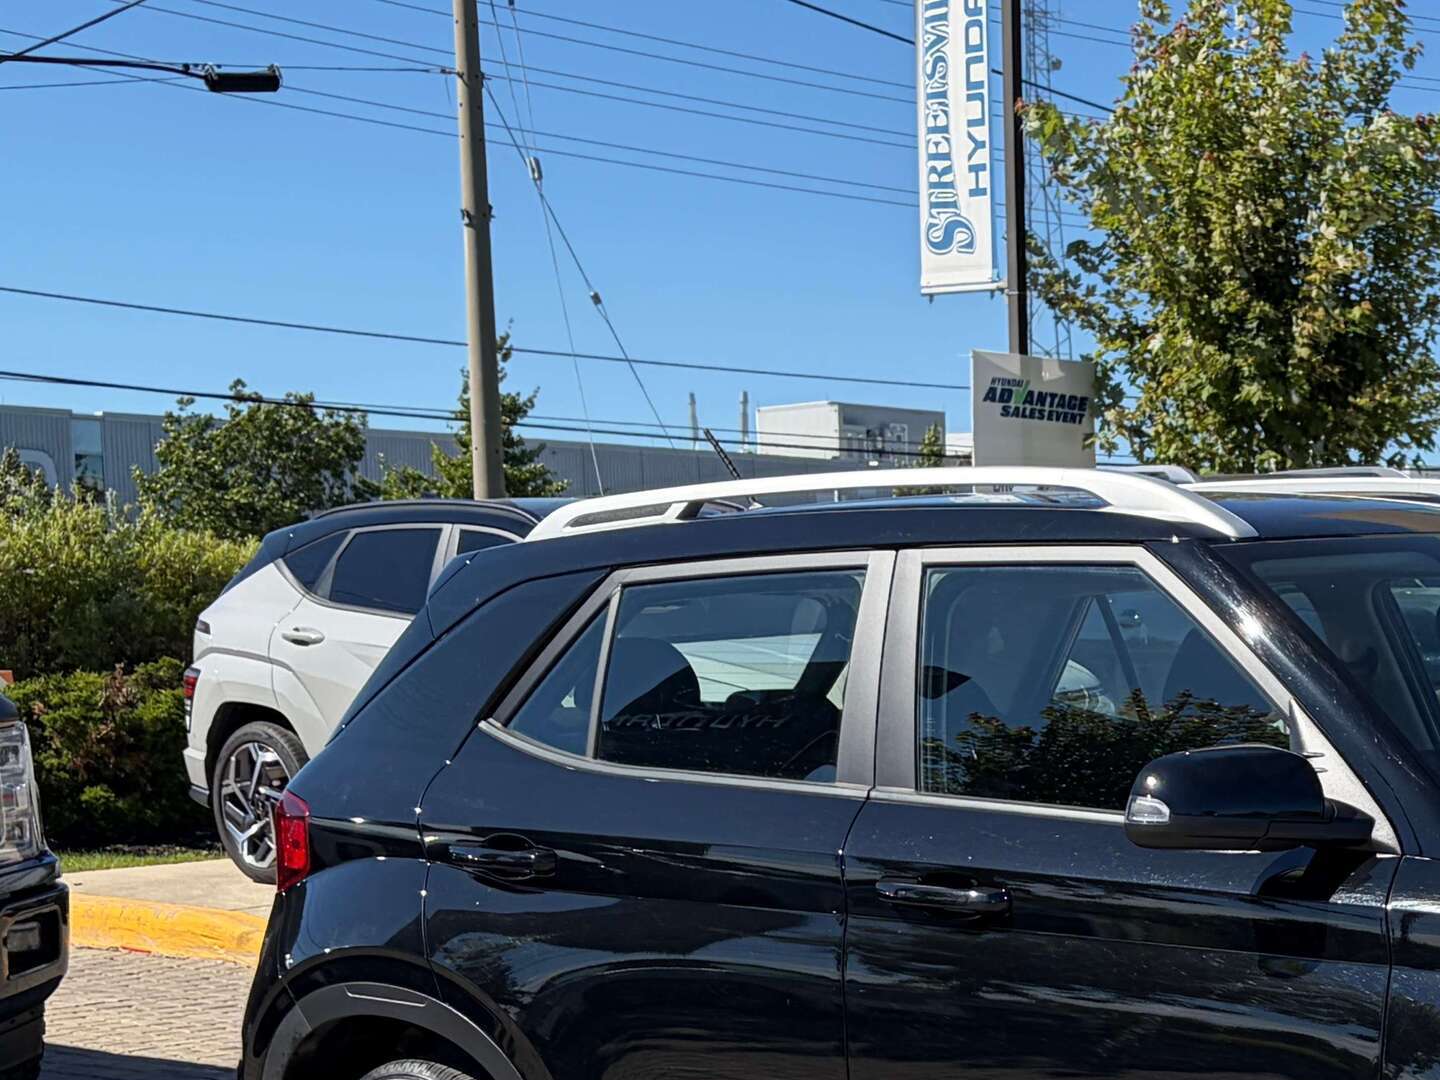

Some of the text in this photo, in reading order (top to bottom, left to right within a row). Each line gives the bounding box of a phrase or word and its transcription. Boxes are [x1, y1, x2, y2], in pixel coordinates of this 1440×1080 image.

[991, 376, 1024, 387] HYUNDAI
[982, 382, 1090, 412] ADVANTAGE
[1000, 405, 1086, 424] SALES EVENT
